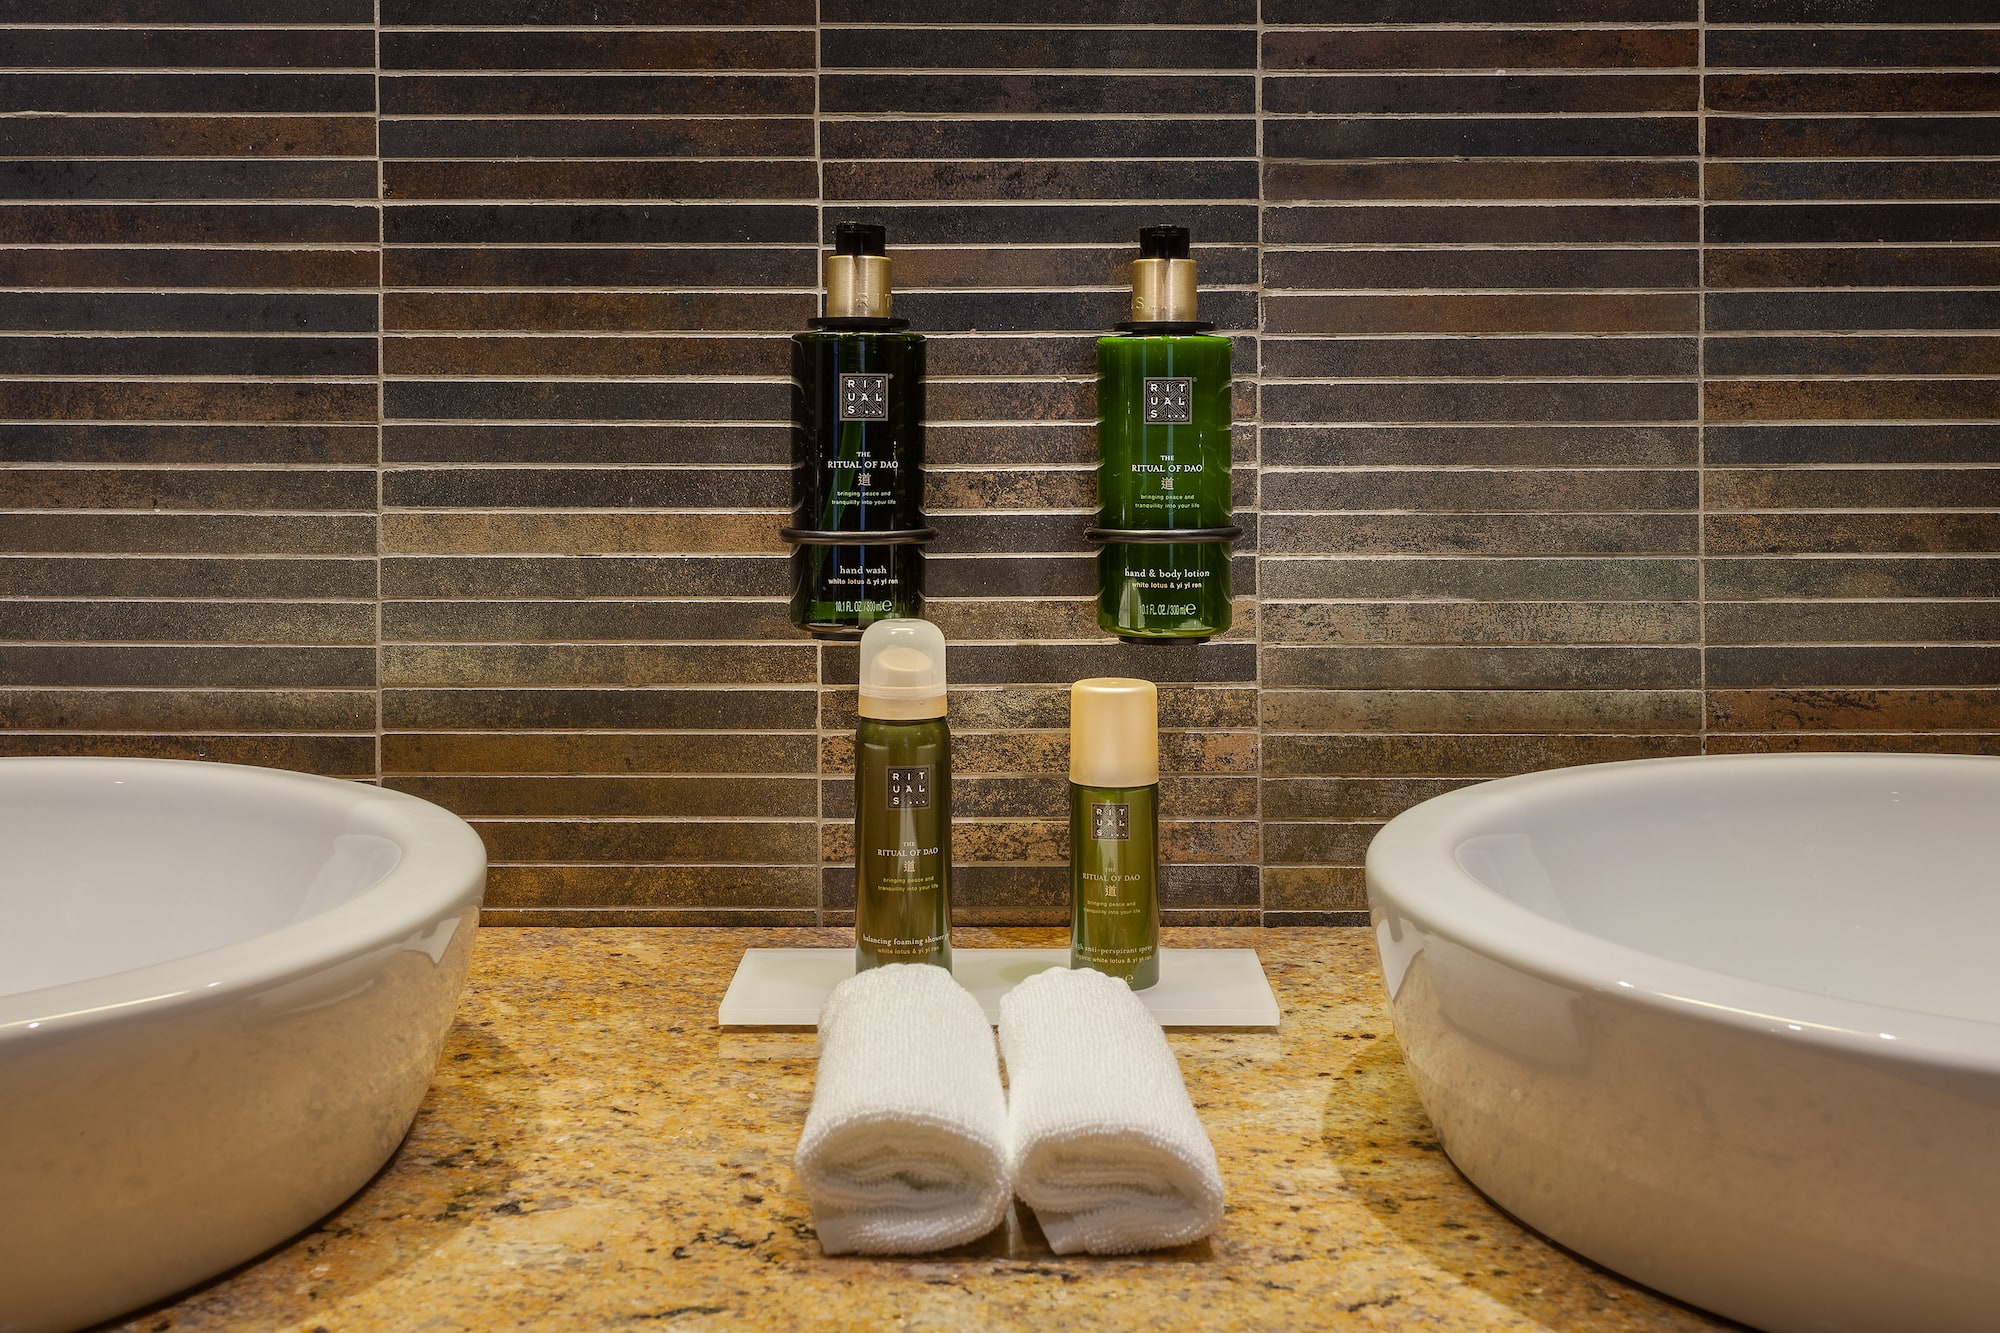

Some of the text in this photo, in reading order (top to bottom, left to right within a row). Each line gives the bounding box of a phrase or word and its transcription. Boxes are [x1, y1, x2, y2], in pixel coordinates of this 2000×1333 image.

[827, 461, 899, 469] RITUAL OF DAO
[1131, 464, 1203, 472] RITUAL OF DAO
[839, 565, 887, 574] hand wash
[1124, 567, 1210, 580] hand & body lotion
[873, 578, 880, 586] yi
[881, 578, 887, 586] yi
[1176, 582, 1182, 590] yi
[1184, 582, 1190, 590] yi
[877, 847, 939, 857] RITUAL OF DAO
[1082, 872, 1108, 881] RITUAL
[1110, 874, 1122, 882] OF
[862, 933, 892, 947] balancing
[893, 938, 924, 947] foaming
[1085, 946, 1137, 956] anti-perspirant
[1138, 945, 1152, 954] spray
